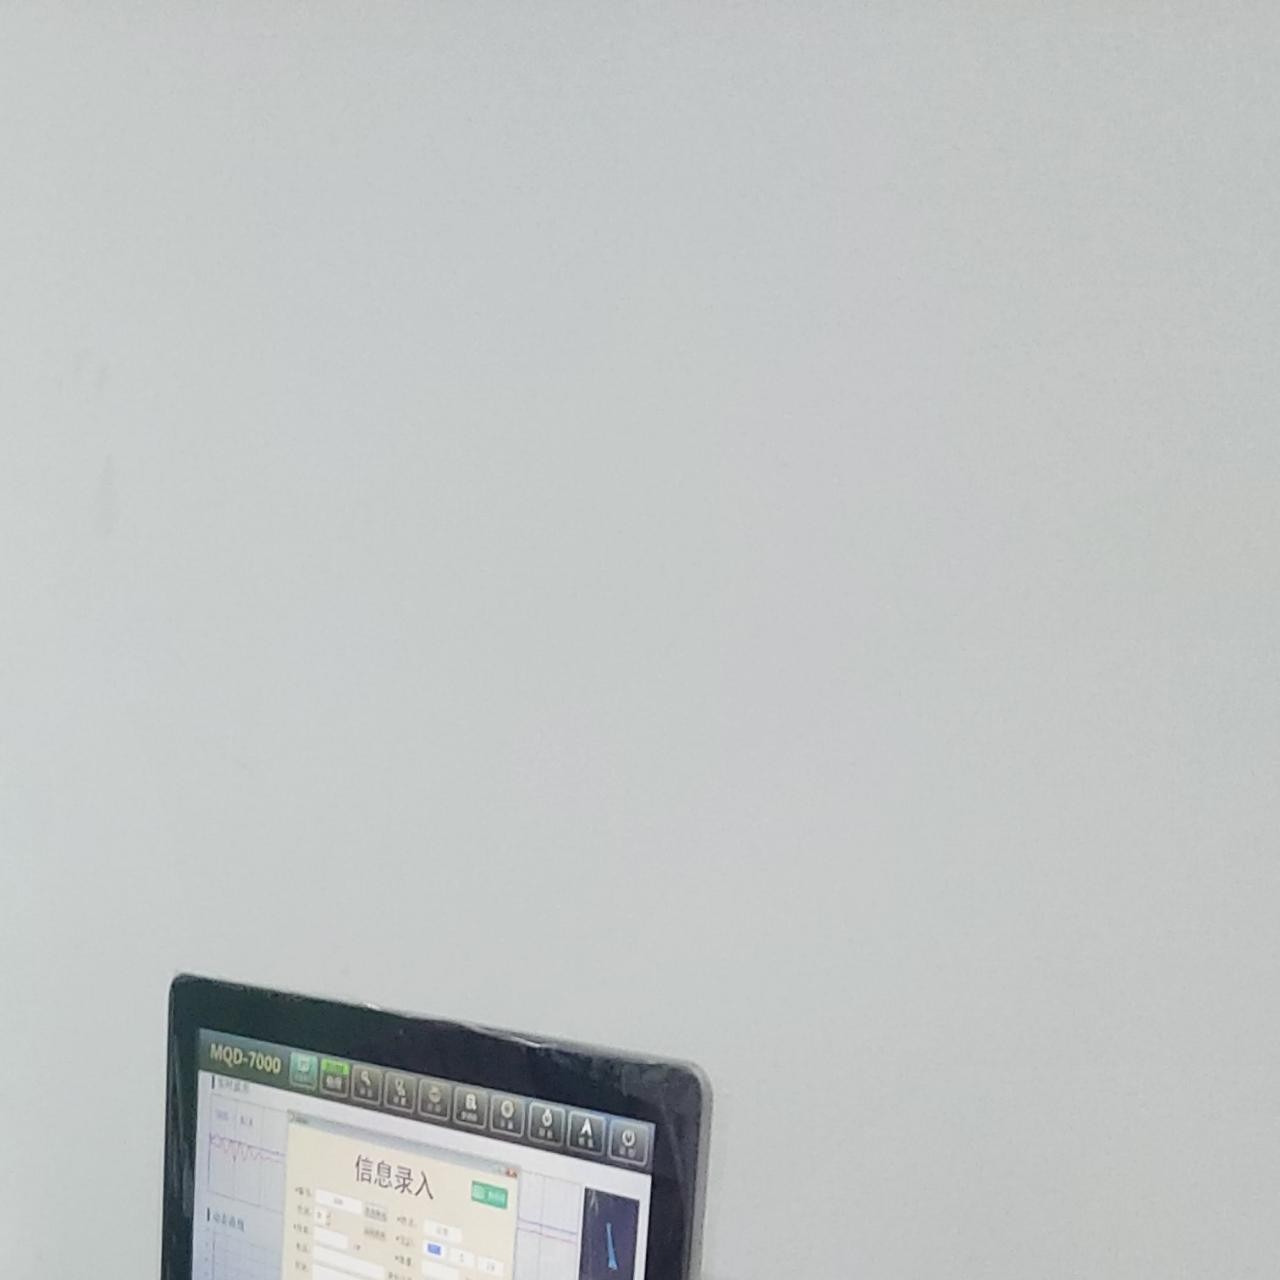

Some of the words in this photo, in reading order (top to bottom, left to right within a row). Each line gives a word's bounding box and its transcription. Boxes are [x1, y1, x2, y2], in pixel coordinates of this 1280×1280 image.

[209, 1043, 282, 1075] MQD-7000
[354, 1153, 435, 1200] 信息录入
